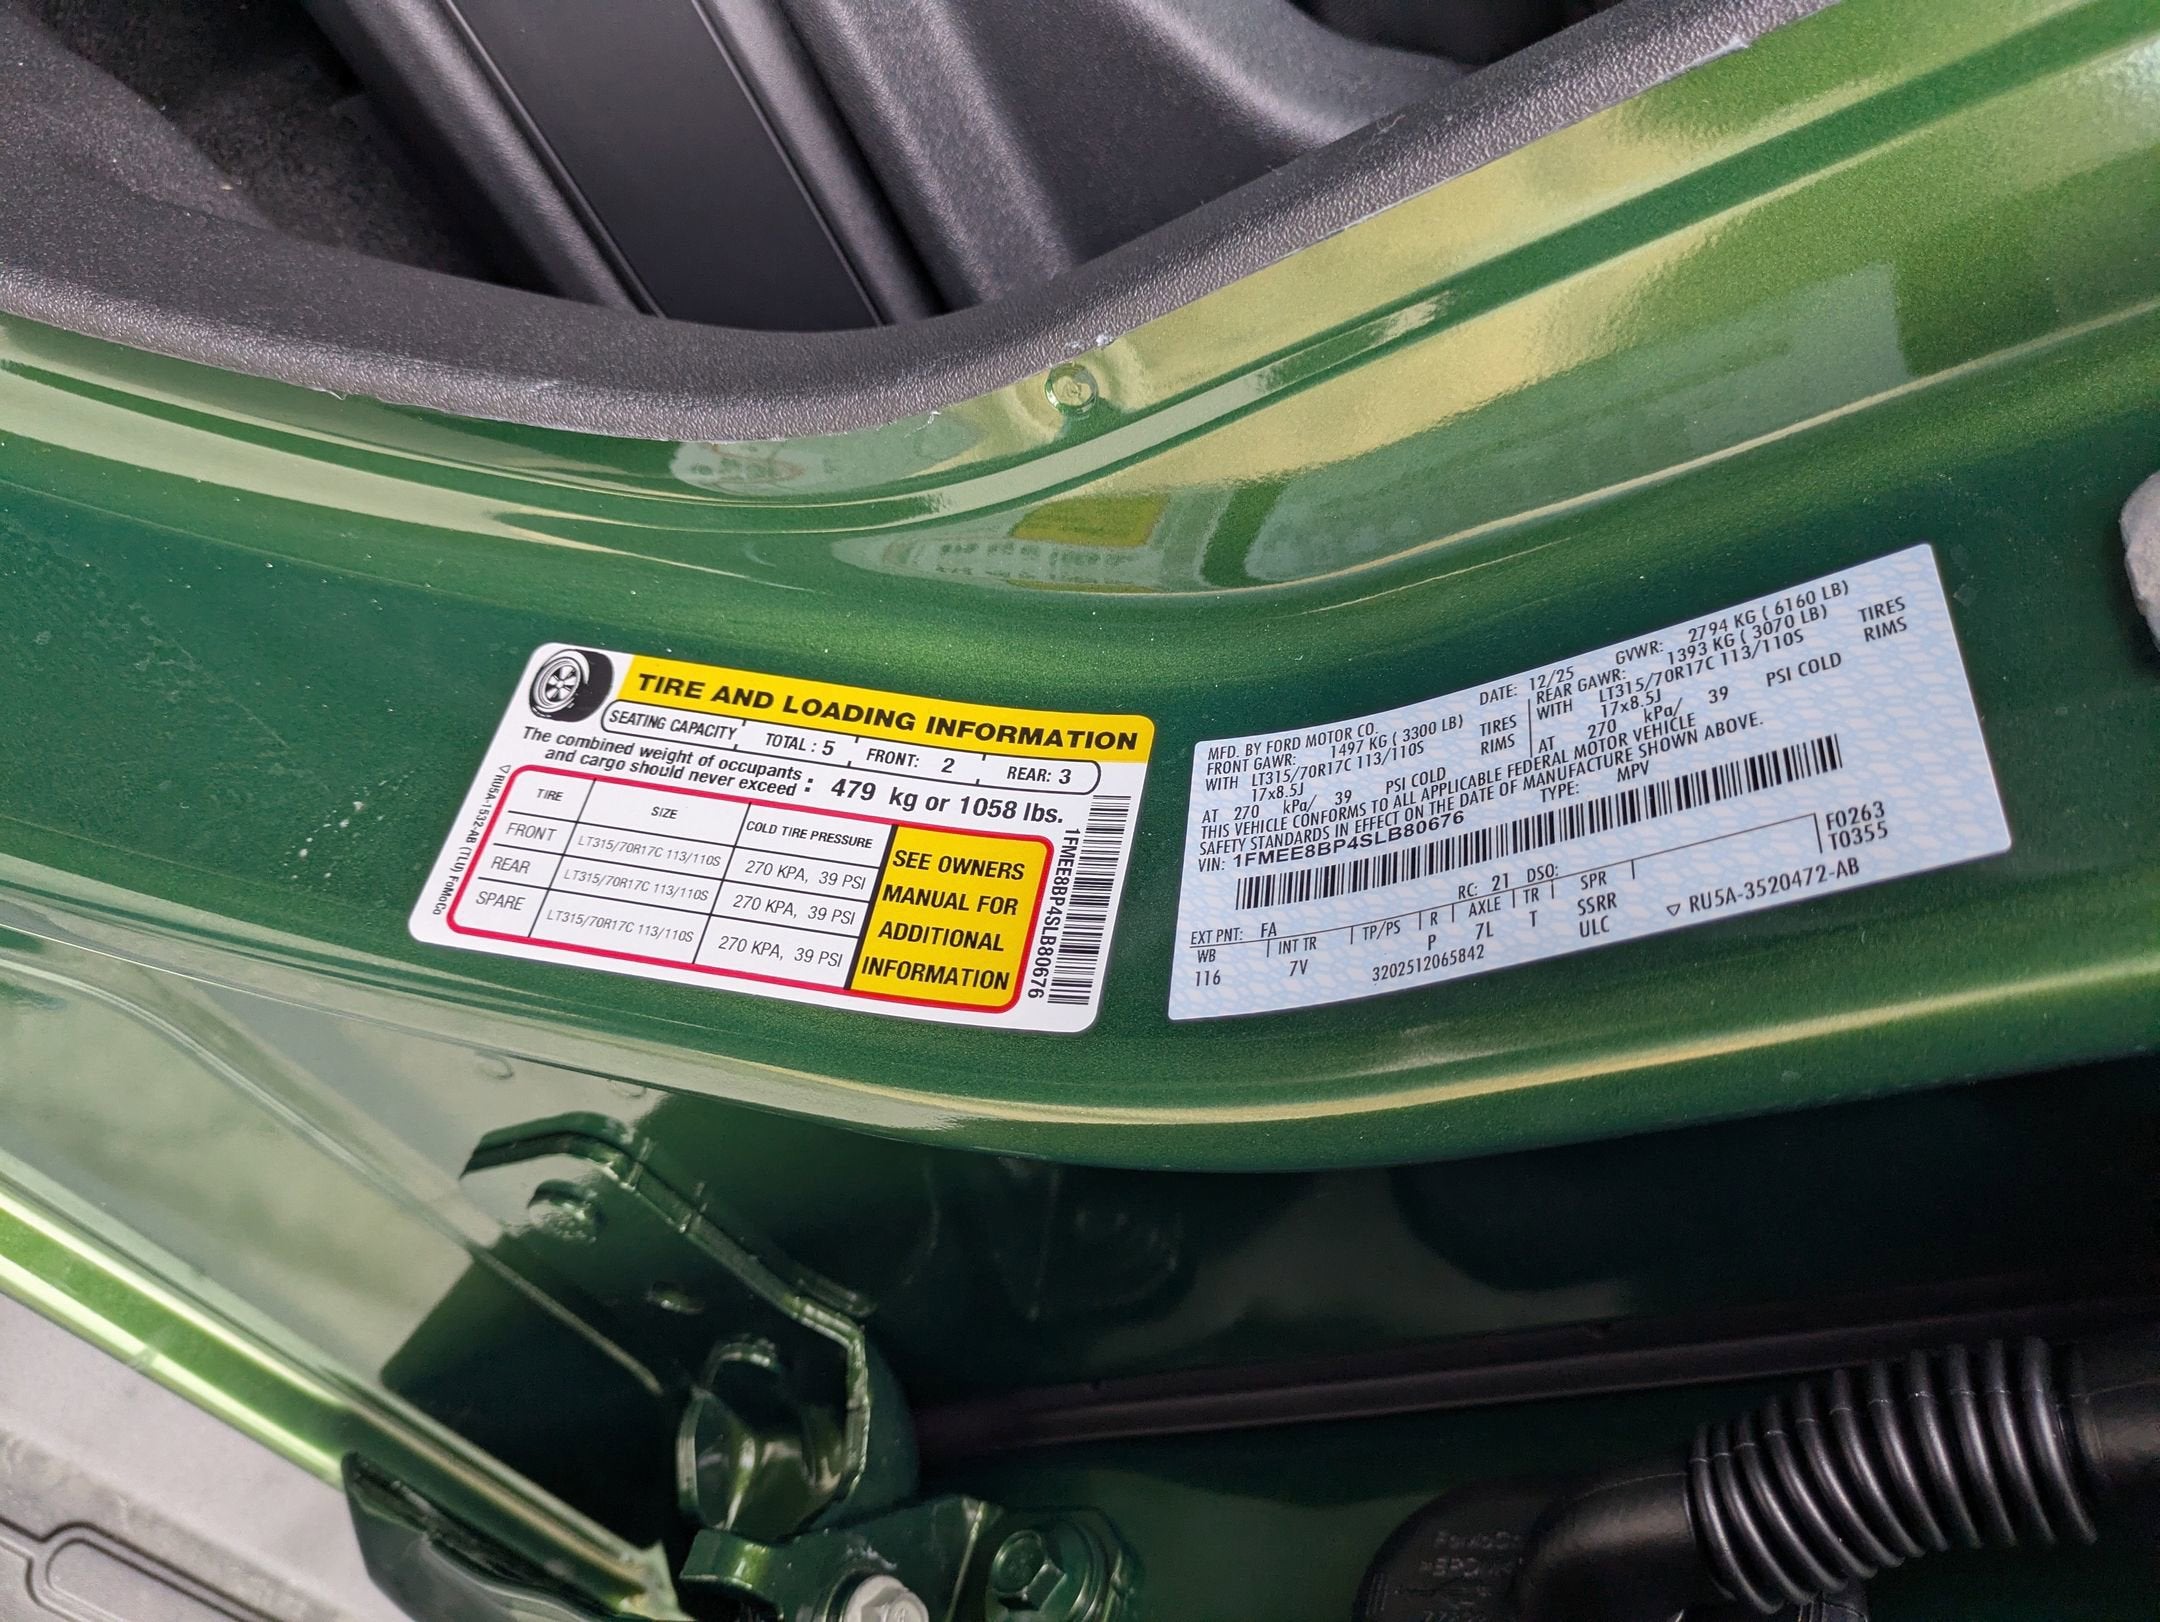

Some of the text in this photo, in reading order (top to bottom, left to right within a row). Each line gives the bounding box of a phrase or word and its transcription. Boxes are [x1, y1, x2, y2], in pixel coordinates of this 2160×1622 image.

[1208, 579, 1849, 760] MFD. BY FORD MOTOR CO. DATE: 12/25 GVWR: 2794 KG 6160 LB)
[1535, 596, 1906, 720] WITH LT315/70R17C 113/110S TIRES
[1536, 603, 1827, 704] REAR GAWR: 1393 KG 3070 LB)
[1601, 616, 1908, 718] 17x8.5J RIMS
[639, 673, 1139, 750] TIRE AND LOADING INFORMATION
[1537, 652, 1842, 754] AT 270 39 PSI COLD
[523, 725, 802, 780] The combined weight of occupants
[608, 709, 667, 729] SEATING
[669, 718, 738, 740] CAPACITY
[821, 739, 836, 755] 5
[866, 748, 919, 767] FRONT:
[940, 757, 955, 773] 2
[1007, 766, 1052, 782] REAR:
[1058, 768, 1072, 784] 3
[1205, 713, 1517, 791] WITH LT315/70R17C 113/110S TIRES
[1206, 713, 1464, 776] FRONT GAWR: 1497 KG 3300 LB)
[1251, 732, 1516, 802] 17x8.5J RIMS
[537, 788, 564, 801] TIRE
[544, 749, 798, 796] and cargo should never exceed
[1199, 711, 1764, 855] SAFETY STANDARDS IN EFFECT ON THE DATE OF MANUFACTURE SHOWN ABOVE.
[1200, 713, 1695, 839] THIS VEHICLE CONFORMS TO ALL APPLICABLE FEDERAL MOTOR VEHICLE
[1201, 766, 1447, 823] AT 270 39 PSI COLD
[651, 806, 679, 819] SIZE
[830, 778, 1063, 823] 479 kg or 1058 lbs.
[1197, 759, 1650, 872] VIN: 1FMEE8BP4SLB80676 TYPE: MPV
[506, 822, 557, 840] FRONT
[578, 835, 720, 866] LT315/70R17C 113/110S
[745, 820, 873, 848] COLD TIRE PRESSURE
[490, 855, 531, 873] REAR
[564, 869, 708, 900] LT315/70R17C 113/110S
[744, 859, 867, 890] 270 KPA, 39 PSI
[892, 849, 1025, 880] SEE OWNERS
[1689, 857, 1860, 912] RU5A-3520472-AB
[475, 891, 526, 910] SPARE
[547, 908, 693, 942] LT315/70R17C 113/110S
[732, 894, 856, 924] 270 KPA, 39 PSI
[881, 883, 1019, 915] MANUAL FOR
[1027, 827, 1081, 998] 1FMEE8BP4SLB80676
[1190, 863, 1559, 944] EXT PNT: FA RC: 21 DSO:
[1197, 870, 1607, 963] WB INT TR TP/PS AXLE SPR
[717, 935, 843, 967] 270 KPA, 39 PSI
[877, 920, 1005, 951] ADDITIONAL
[1195, 891, 1618, 986] 116 7V 7L SSRR
[1371, 915, 1610, 981] 3202512065842 ULC
[861, 955, 1011, 990] INFORMATION
